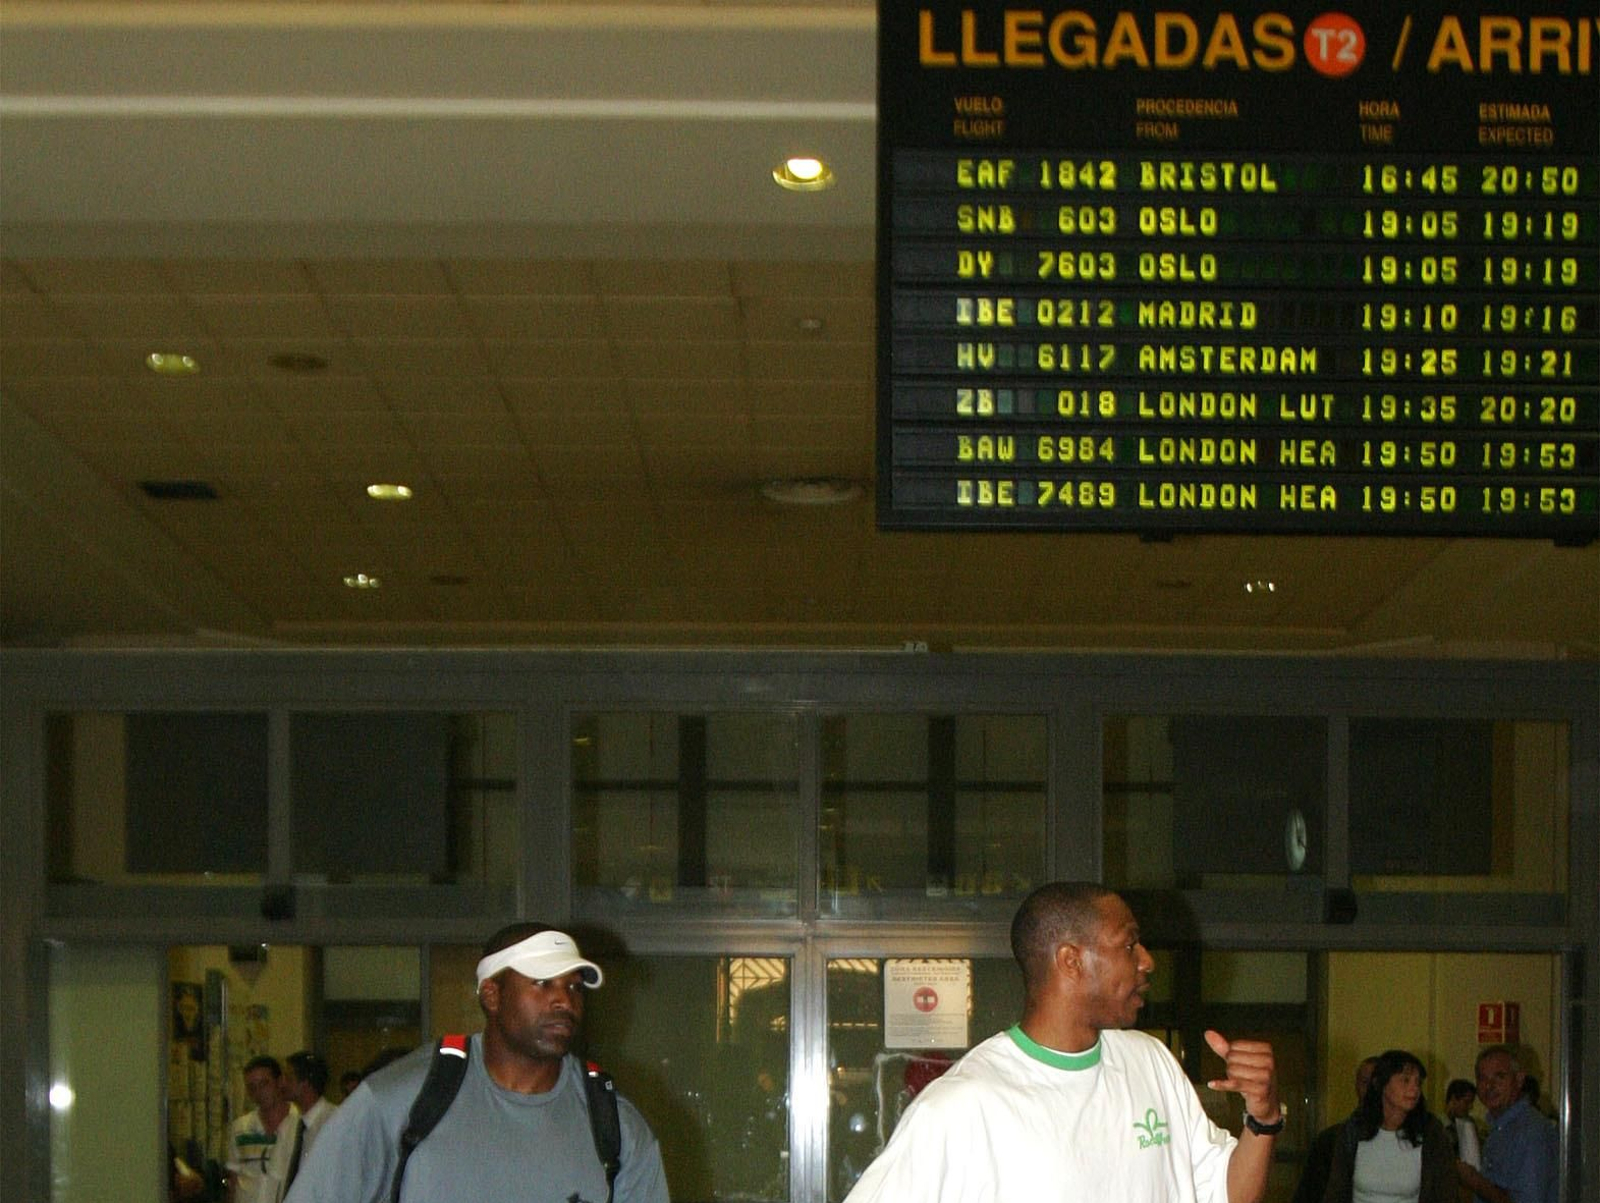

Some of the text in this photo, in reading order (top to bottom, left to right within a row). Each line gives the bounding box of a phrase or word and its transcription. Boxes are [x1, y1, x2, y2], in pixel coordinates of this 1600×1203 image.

[920, 11, 1600, 74] LLEGADAS T2 / ARRI
[955, 97, 1004, 115] VUELO
[1137, 99, 1239, 117] PROCEDENCIA
[1360, 102, 1401, 118] HORA
[1480, 104, 1552, 122] ESTIMADA
[954, 120, 1004, 138] FLIGHT
[1137, 122, 1179, 139] FROM
[1362, 125, 1393, 143] TIME
[1479, 127, 1555, 146] EXPECTED
[958, 161, 1579, 195] EAF 1842 BRISTOL 16:45 20:50
[958, 207, 1579, 240] SNB 603 OSLO 19:05 19:19
[958, 252, 1579, 285] DY 7603 OSLO 19:05 19:19
[957, 299, 1578, 333] IBE 0212 MADRID 19:10 19:16
[958, 344, 1573, 377] HV 6117 AMSTERDAM 19:25 19:21
[957, 390, 1577, 424] ZB 018 LONDON LUT 19:35 20:20
[958, 436, 1577, 469] BAW 6984 LONDON HEA 19:50 19:53
[958, 481, 1577, 514] IBE 7489 LONDON HEA 19:50 19:53
